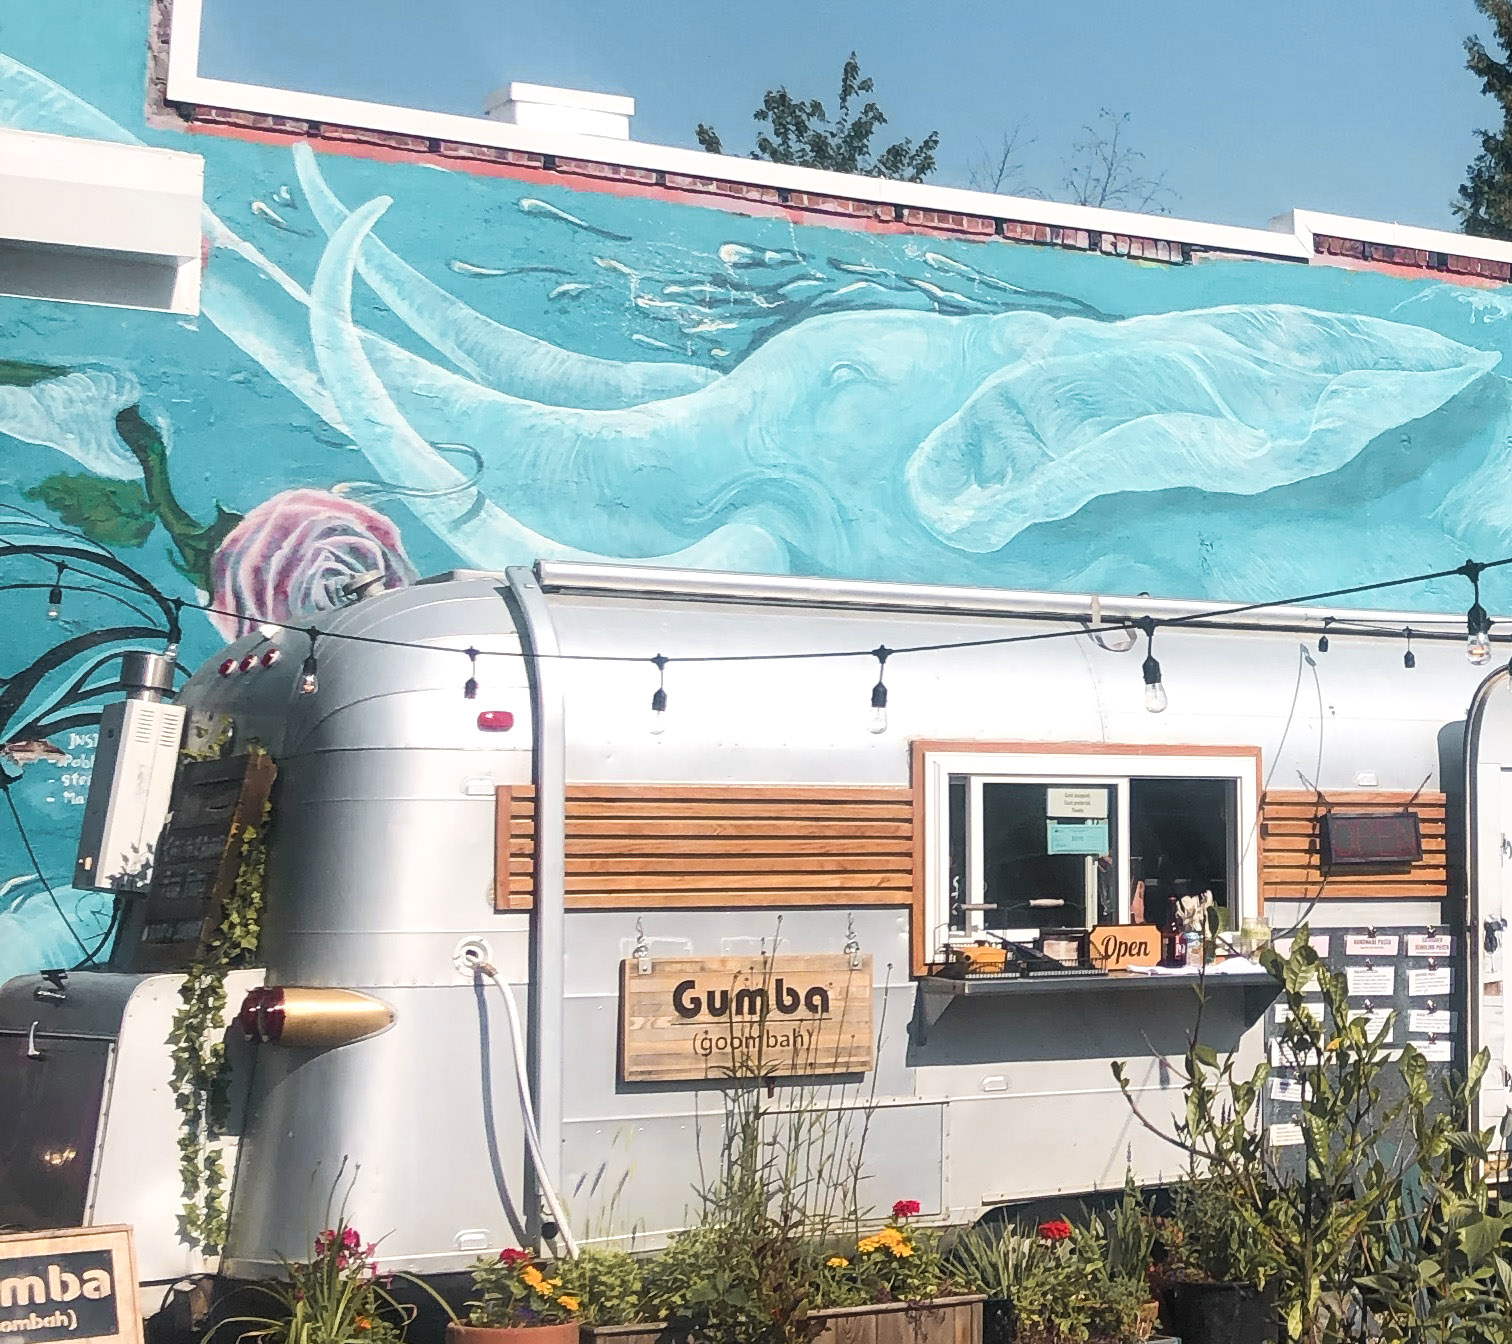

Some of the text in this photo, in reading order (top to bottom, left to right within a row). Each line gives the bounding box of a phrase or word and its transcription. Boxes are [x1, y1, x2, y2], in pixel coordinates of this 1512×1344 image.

[1101, 934, 1151, 965] Open
[672, 978, 830, 1019] Gumba
[692, 1027, 813, 1057] (goombah)
[0, 1308, 78, 1333] ombah)
